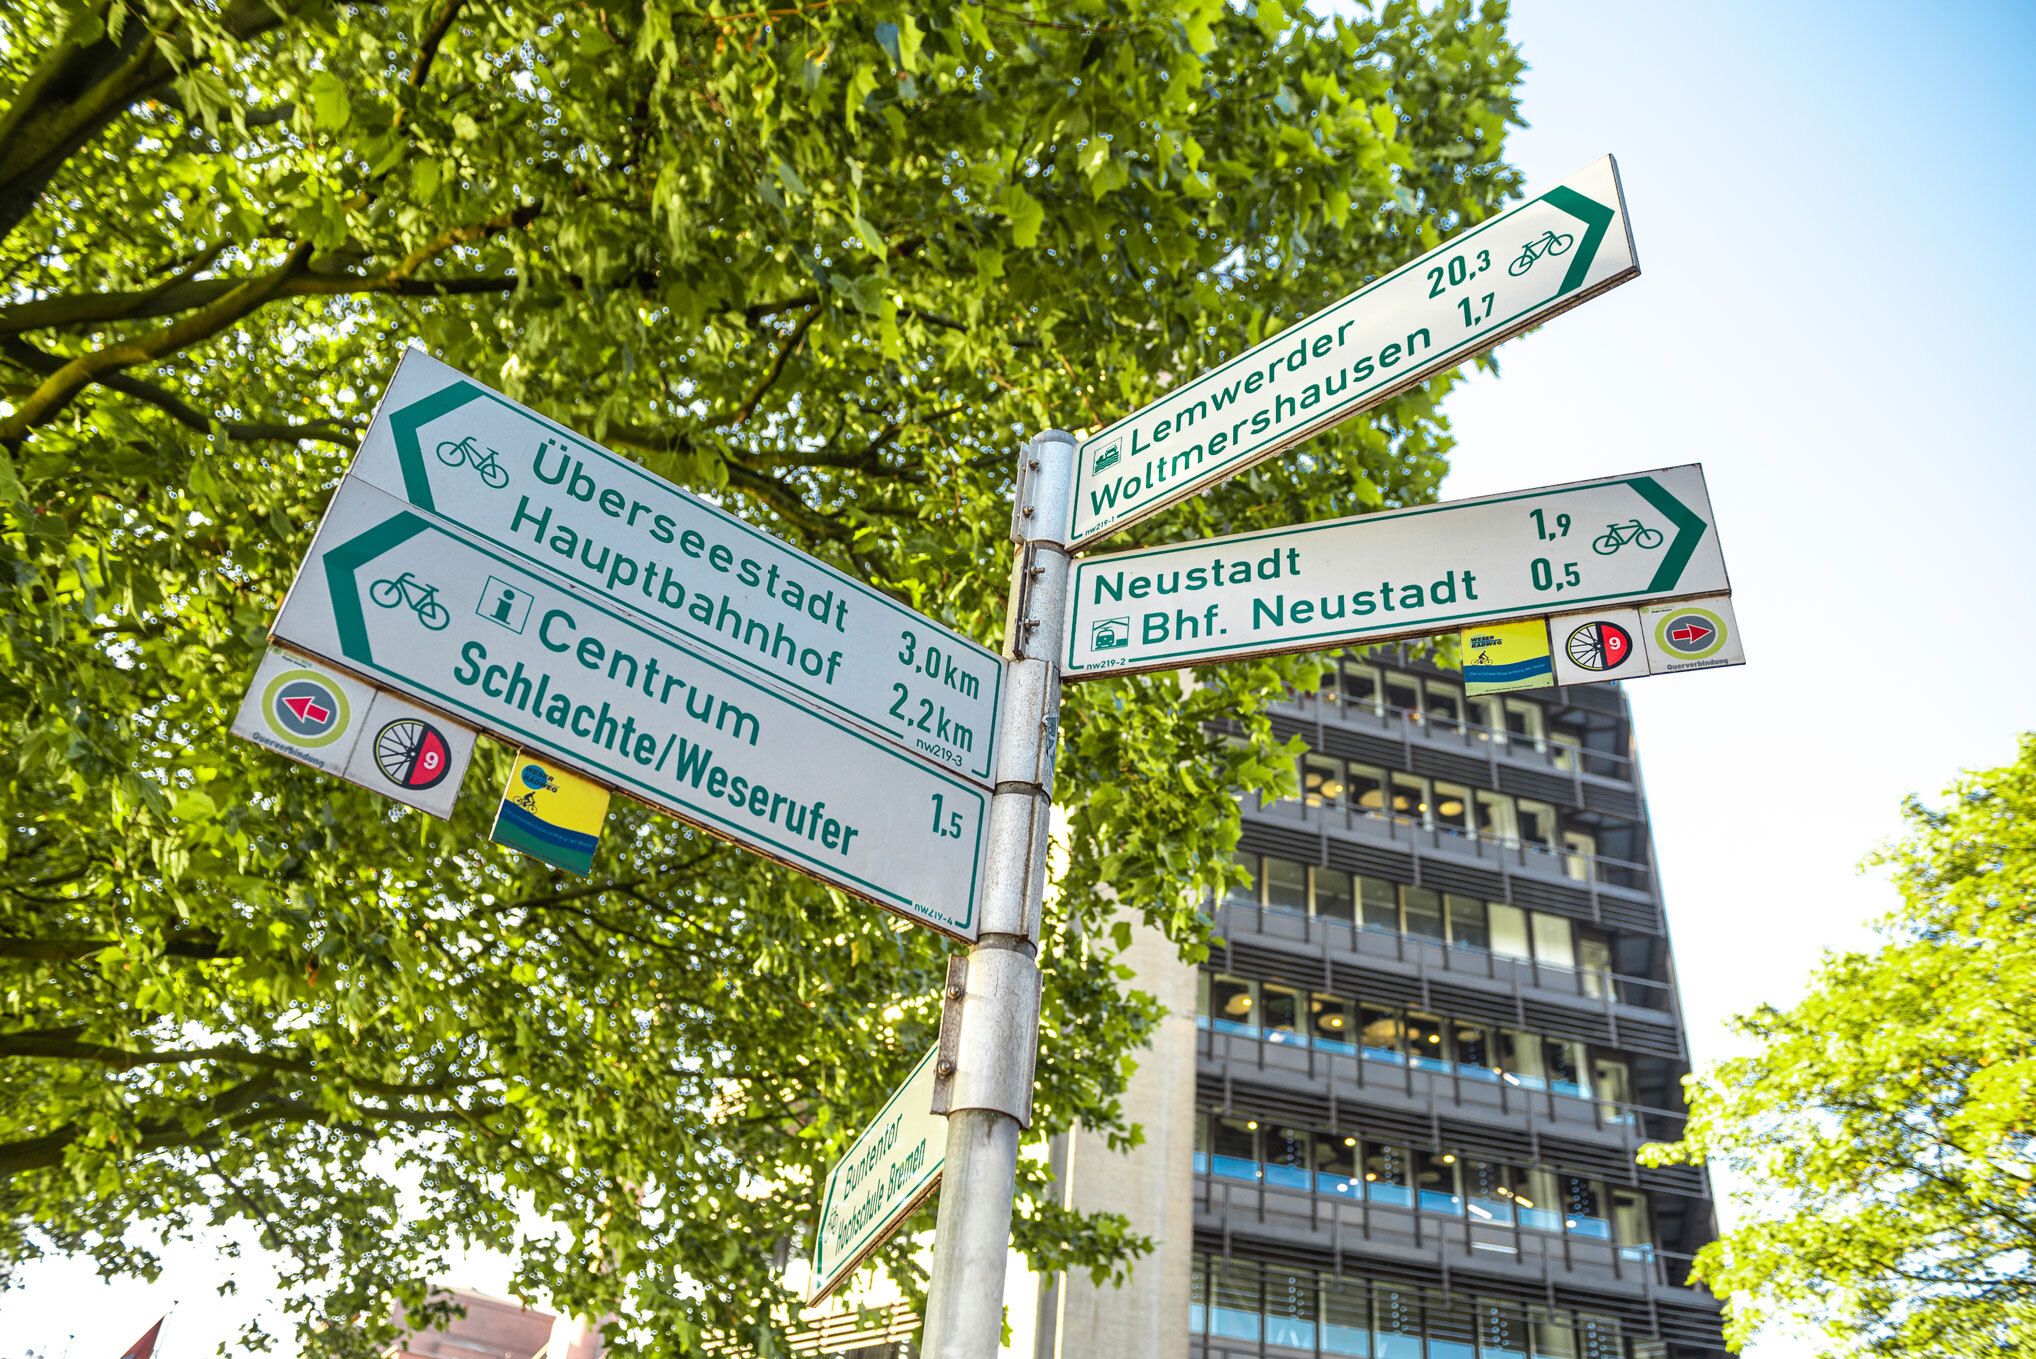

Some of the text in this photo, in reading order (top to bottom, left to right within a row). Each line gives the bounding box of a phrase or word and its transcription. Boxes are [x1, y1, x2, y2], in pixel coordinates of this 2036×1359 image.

[1132, 250, 1490, 456] Lemwerder 20,3
[1091, 292, 1494, 515] Woltmershausen 1,7
[532, 438, 848, 633] Überseestadt
[1085, 516, 1115, 536] nw219-1
[1094, 508, 1571, 604] Neustadt 1,9
[510, 495, 843, 685] Hauptbahnhof
[1531, 558, 1580, 592] 0,5
[1142, 570, 1478, 645] Bhf. Neustadt
[1470, 635, 1495, 643] WESER
[1471, 640, 1503, 648] RADWEG
[1609, 636, 1621, 650] 9
[538, 609, 760, 747] Centrum
[1086, 657, 1126, 670] nw219-2
[1666, 657, 1729, 671] Querverbindung
[252, 731, 325, 768] Querverbindung
[422, 752, 439, 769] 9
[453, 641, 963, 856] Schlachte/Weserufer 1,5
[916, 738, 963, 767] nw219-3
[523, 774, 558, 793] RADWEG
[525, 766, 554, 782] WESER
[843, 1113, 903, 1201] Buntentor
[835, 1137, 926, 1257] Hochschule Bremen
